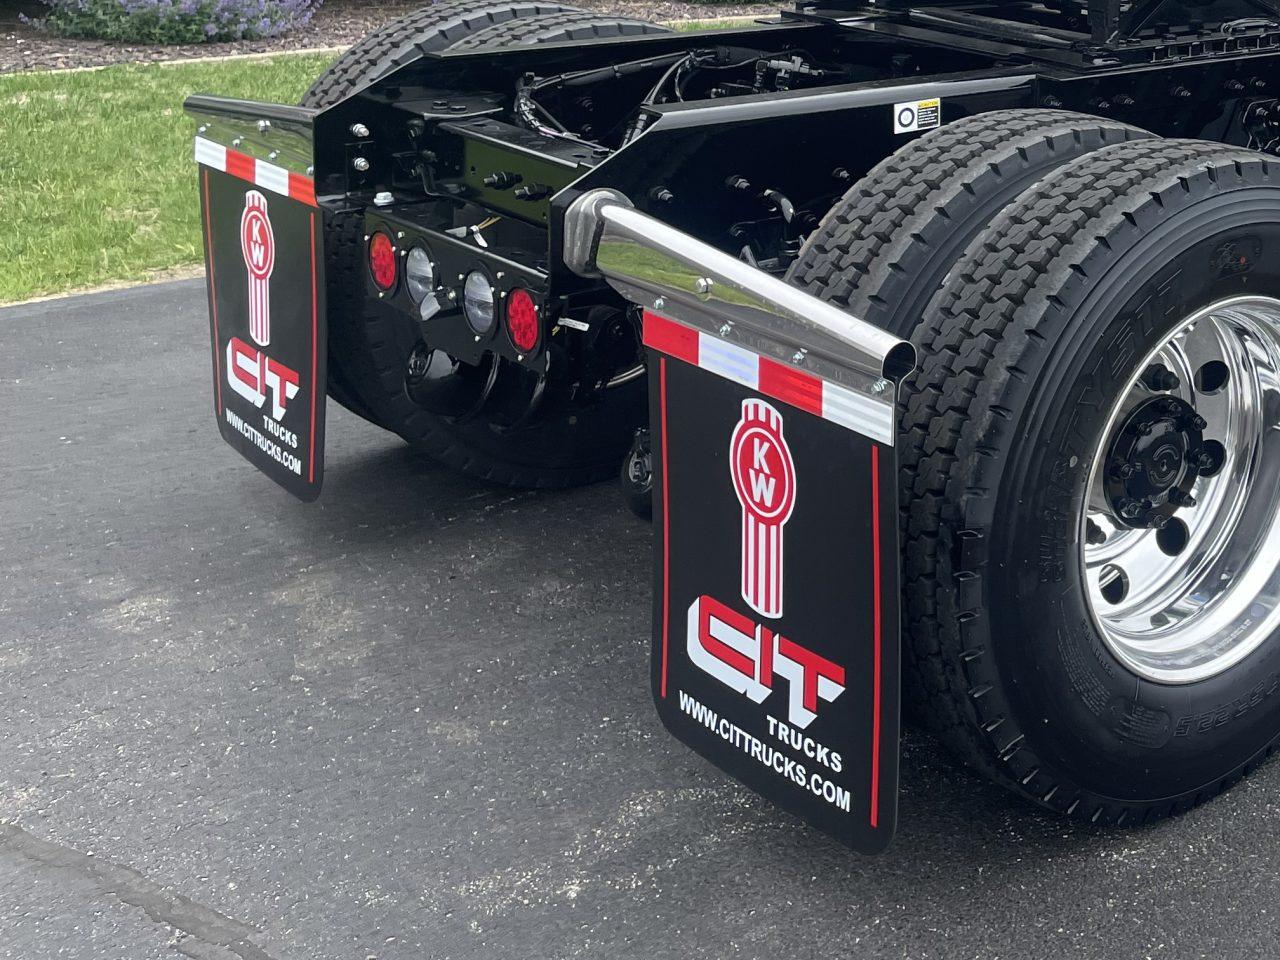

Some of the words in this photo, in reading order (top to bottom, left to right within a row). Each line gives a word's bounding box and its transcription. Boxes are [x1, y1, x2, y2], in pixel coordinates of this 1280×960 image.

[226, 337, 299, 421] CIT
[225, 407, 302, 476] WWW.CITTRUCKS.COM
[263, 414, 298, 449] TRUCKS
[687, 594, 846, 730] CIT
[679, 689, 851, 813] WWW.CITTRUCKS.COM
[766, 714, 843, 772] TRUCKS
